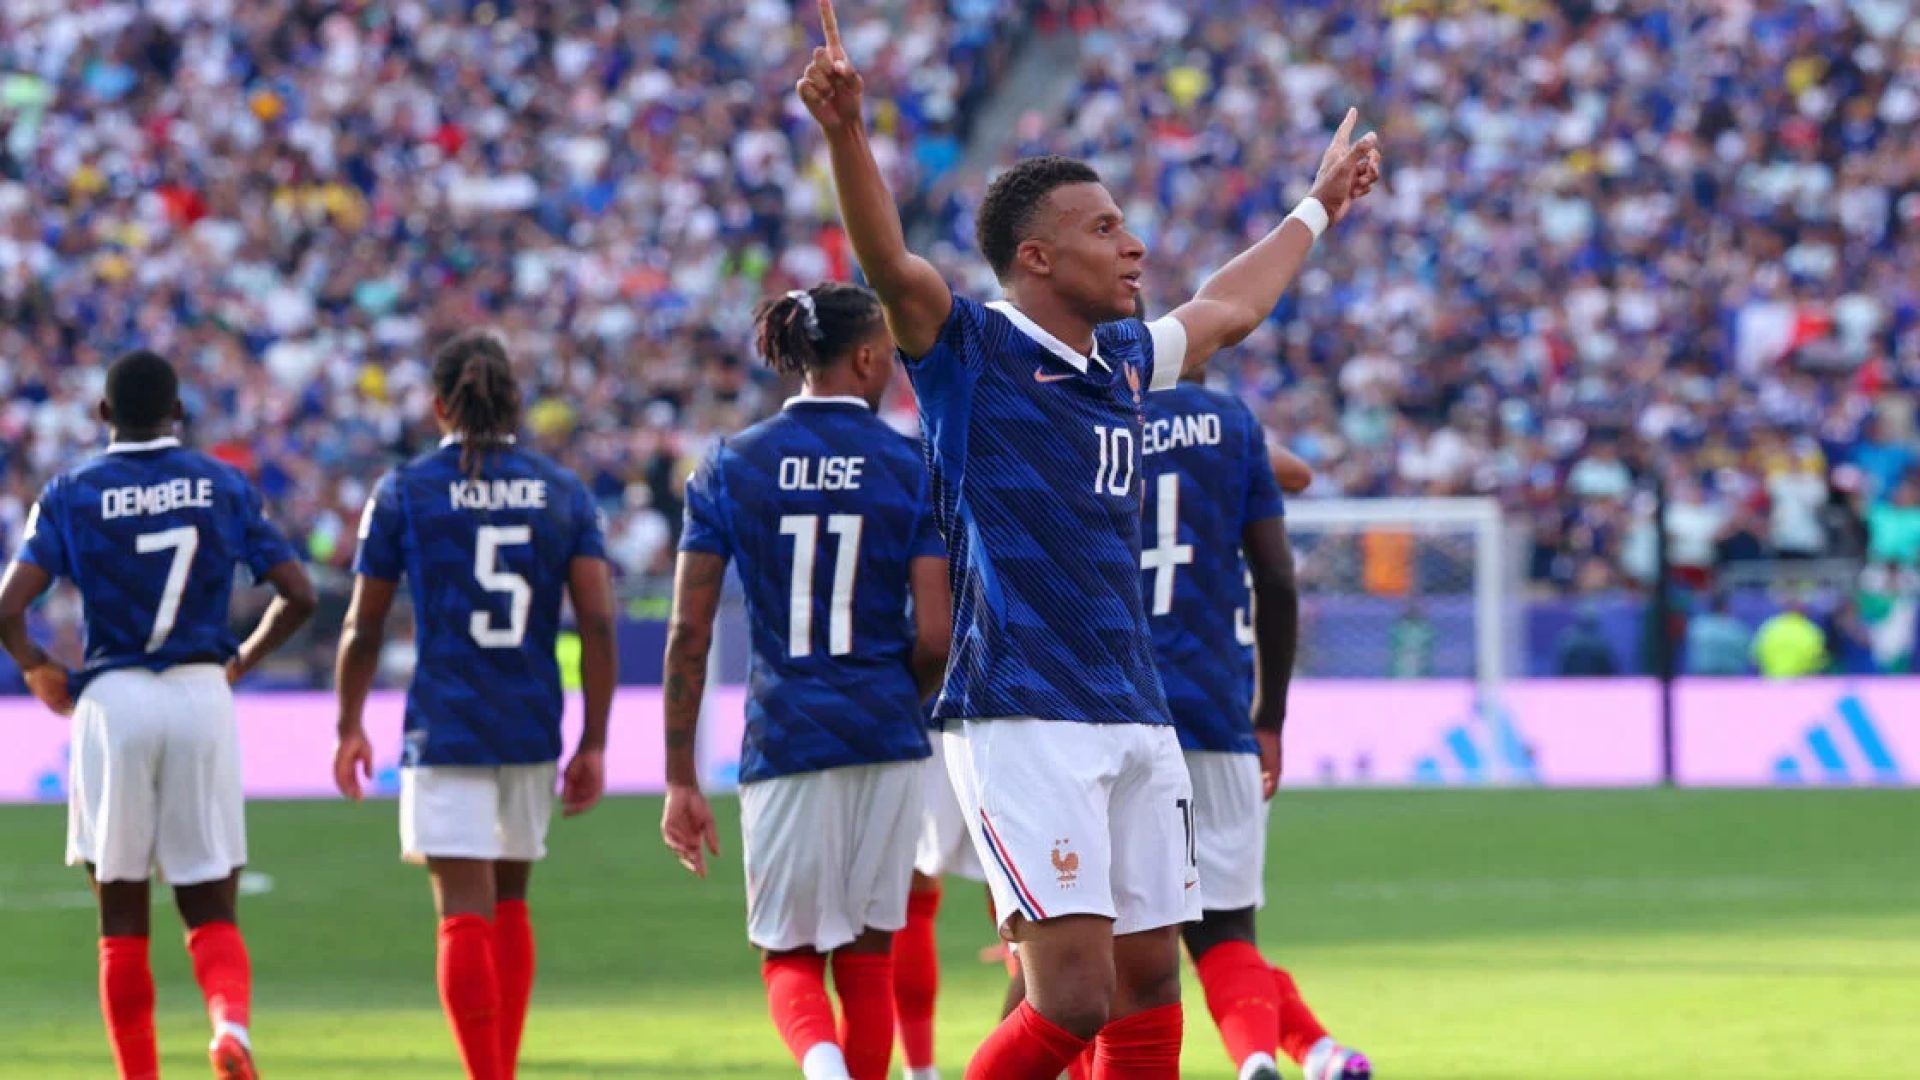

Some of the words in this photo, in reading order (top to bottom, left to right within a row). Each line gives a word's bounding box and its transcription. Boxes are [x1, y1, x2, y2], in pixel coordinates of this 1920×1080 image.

[449, 479, 548, 511] KOUNDE
[779, 456, 865, 490] OLISE
[1094, 425, 1133, 496] 10
[102, 478, 213, 520] DEMBELE
[136, 525, 199, 654] 7
[469, 525, 533, 648] 5
[780, 514, 863, 658] 11
